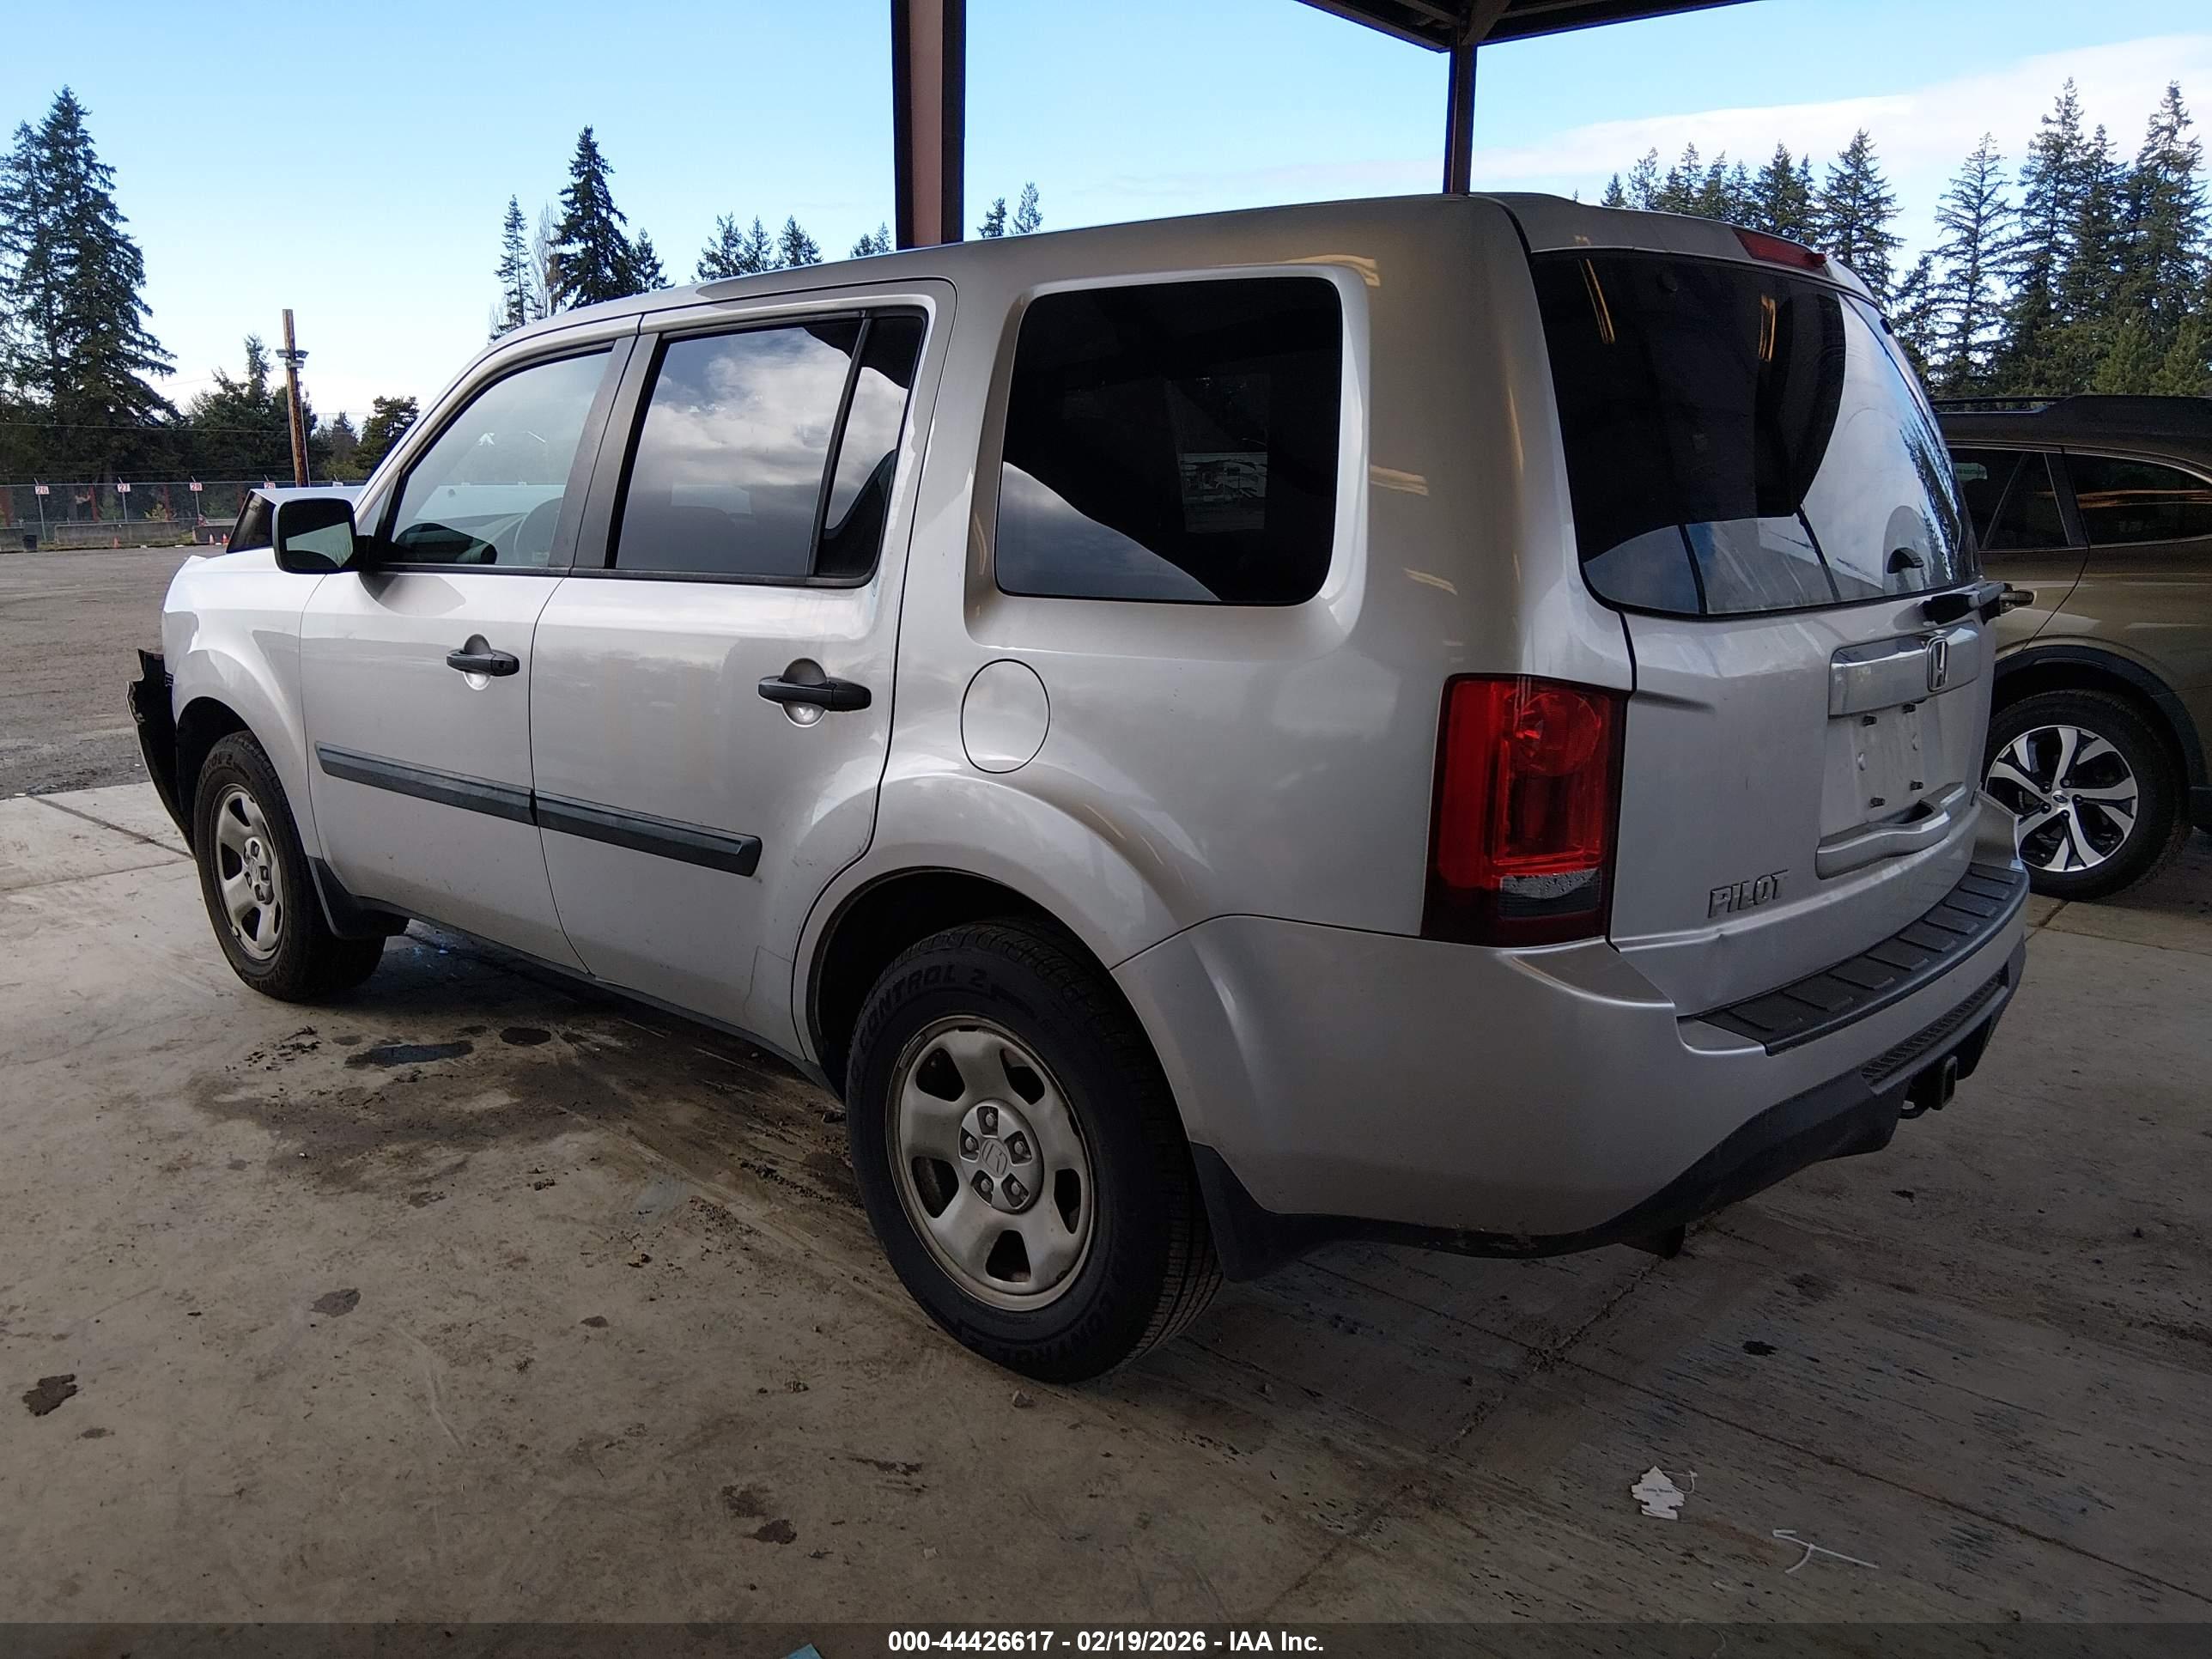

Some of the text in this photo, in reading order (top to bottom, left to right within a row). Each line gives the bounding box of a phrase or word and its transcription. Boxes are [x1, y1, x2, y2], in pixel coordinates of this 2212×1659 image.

[36, 486, 48, 495] 26
[118, 483, 128, 492] 27
[191, 483, 201, 491] 28
[1707, 868, 1790, 919] PILOT
[859, 963, 988, 1050] CONTROL 2
